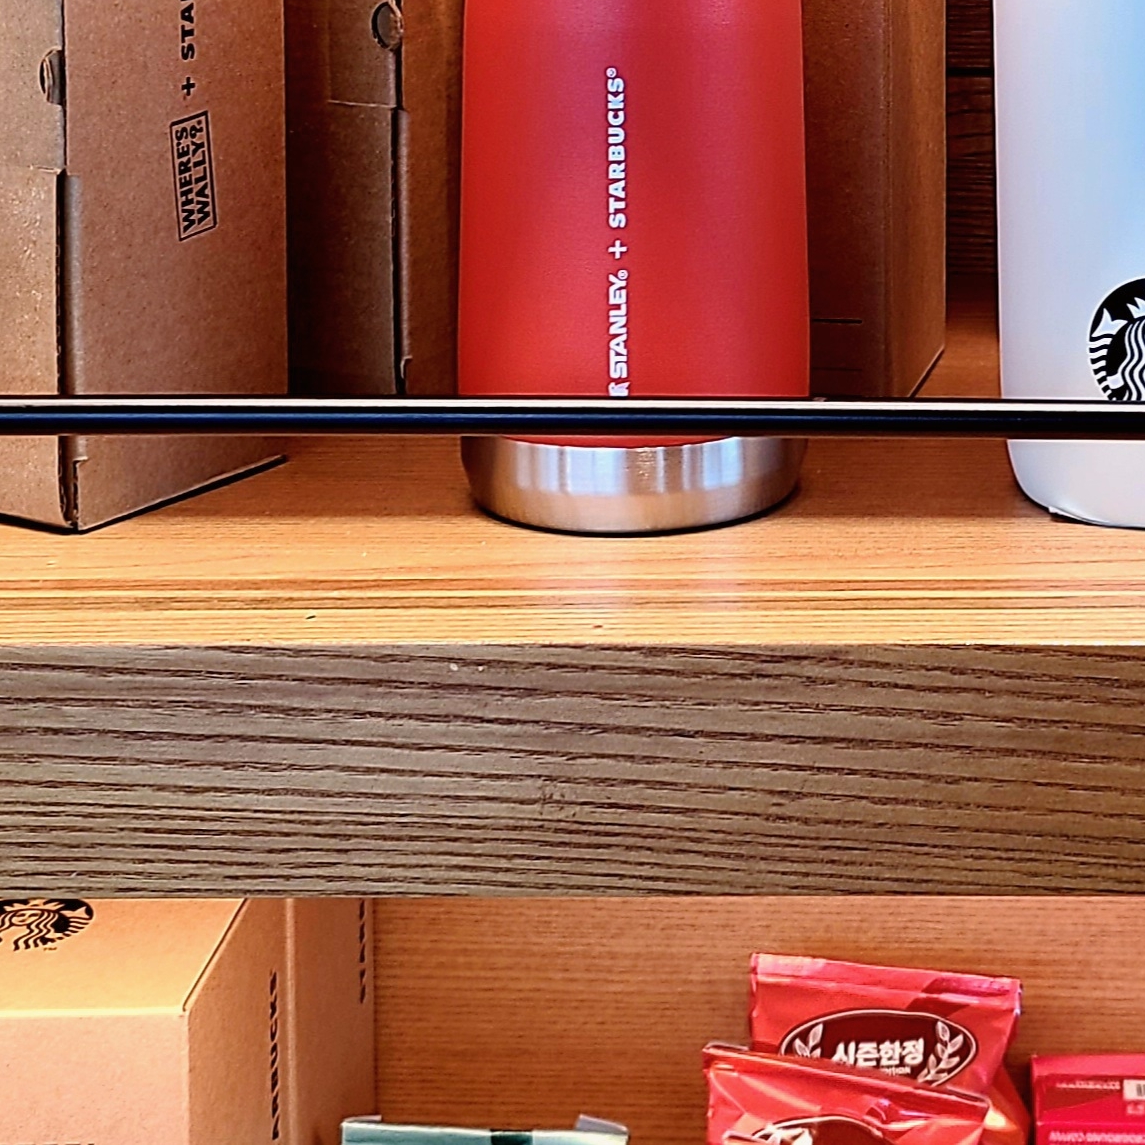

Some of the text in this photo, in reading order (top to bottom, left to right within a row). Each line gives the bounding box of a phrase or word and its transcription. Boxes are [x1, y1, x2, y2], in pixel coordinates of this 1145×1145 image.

[175, 126, 197, 234] WHERE'S
[607, 77, 627, 229] STARBUCKS
[608, 273, 629, 379] STANLEY
[269, 970, 280, 1141] ARBUCKS
[831, 1037, 924, 1067] 시즌한정
